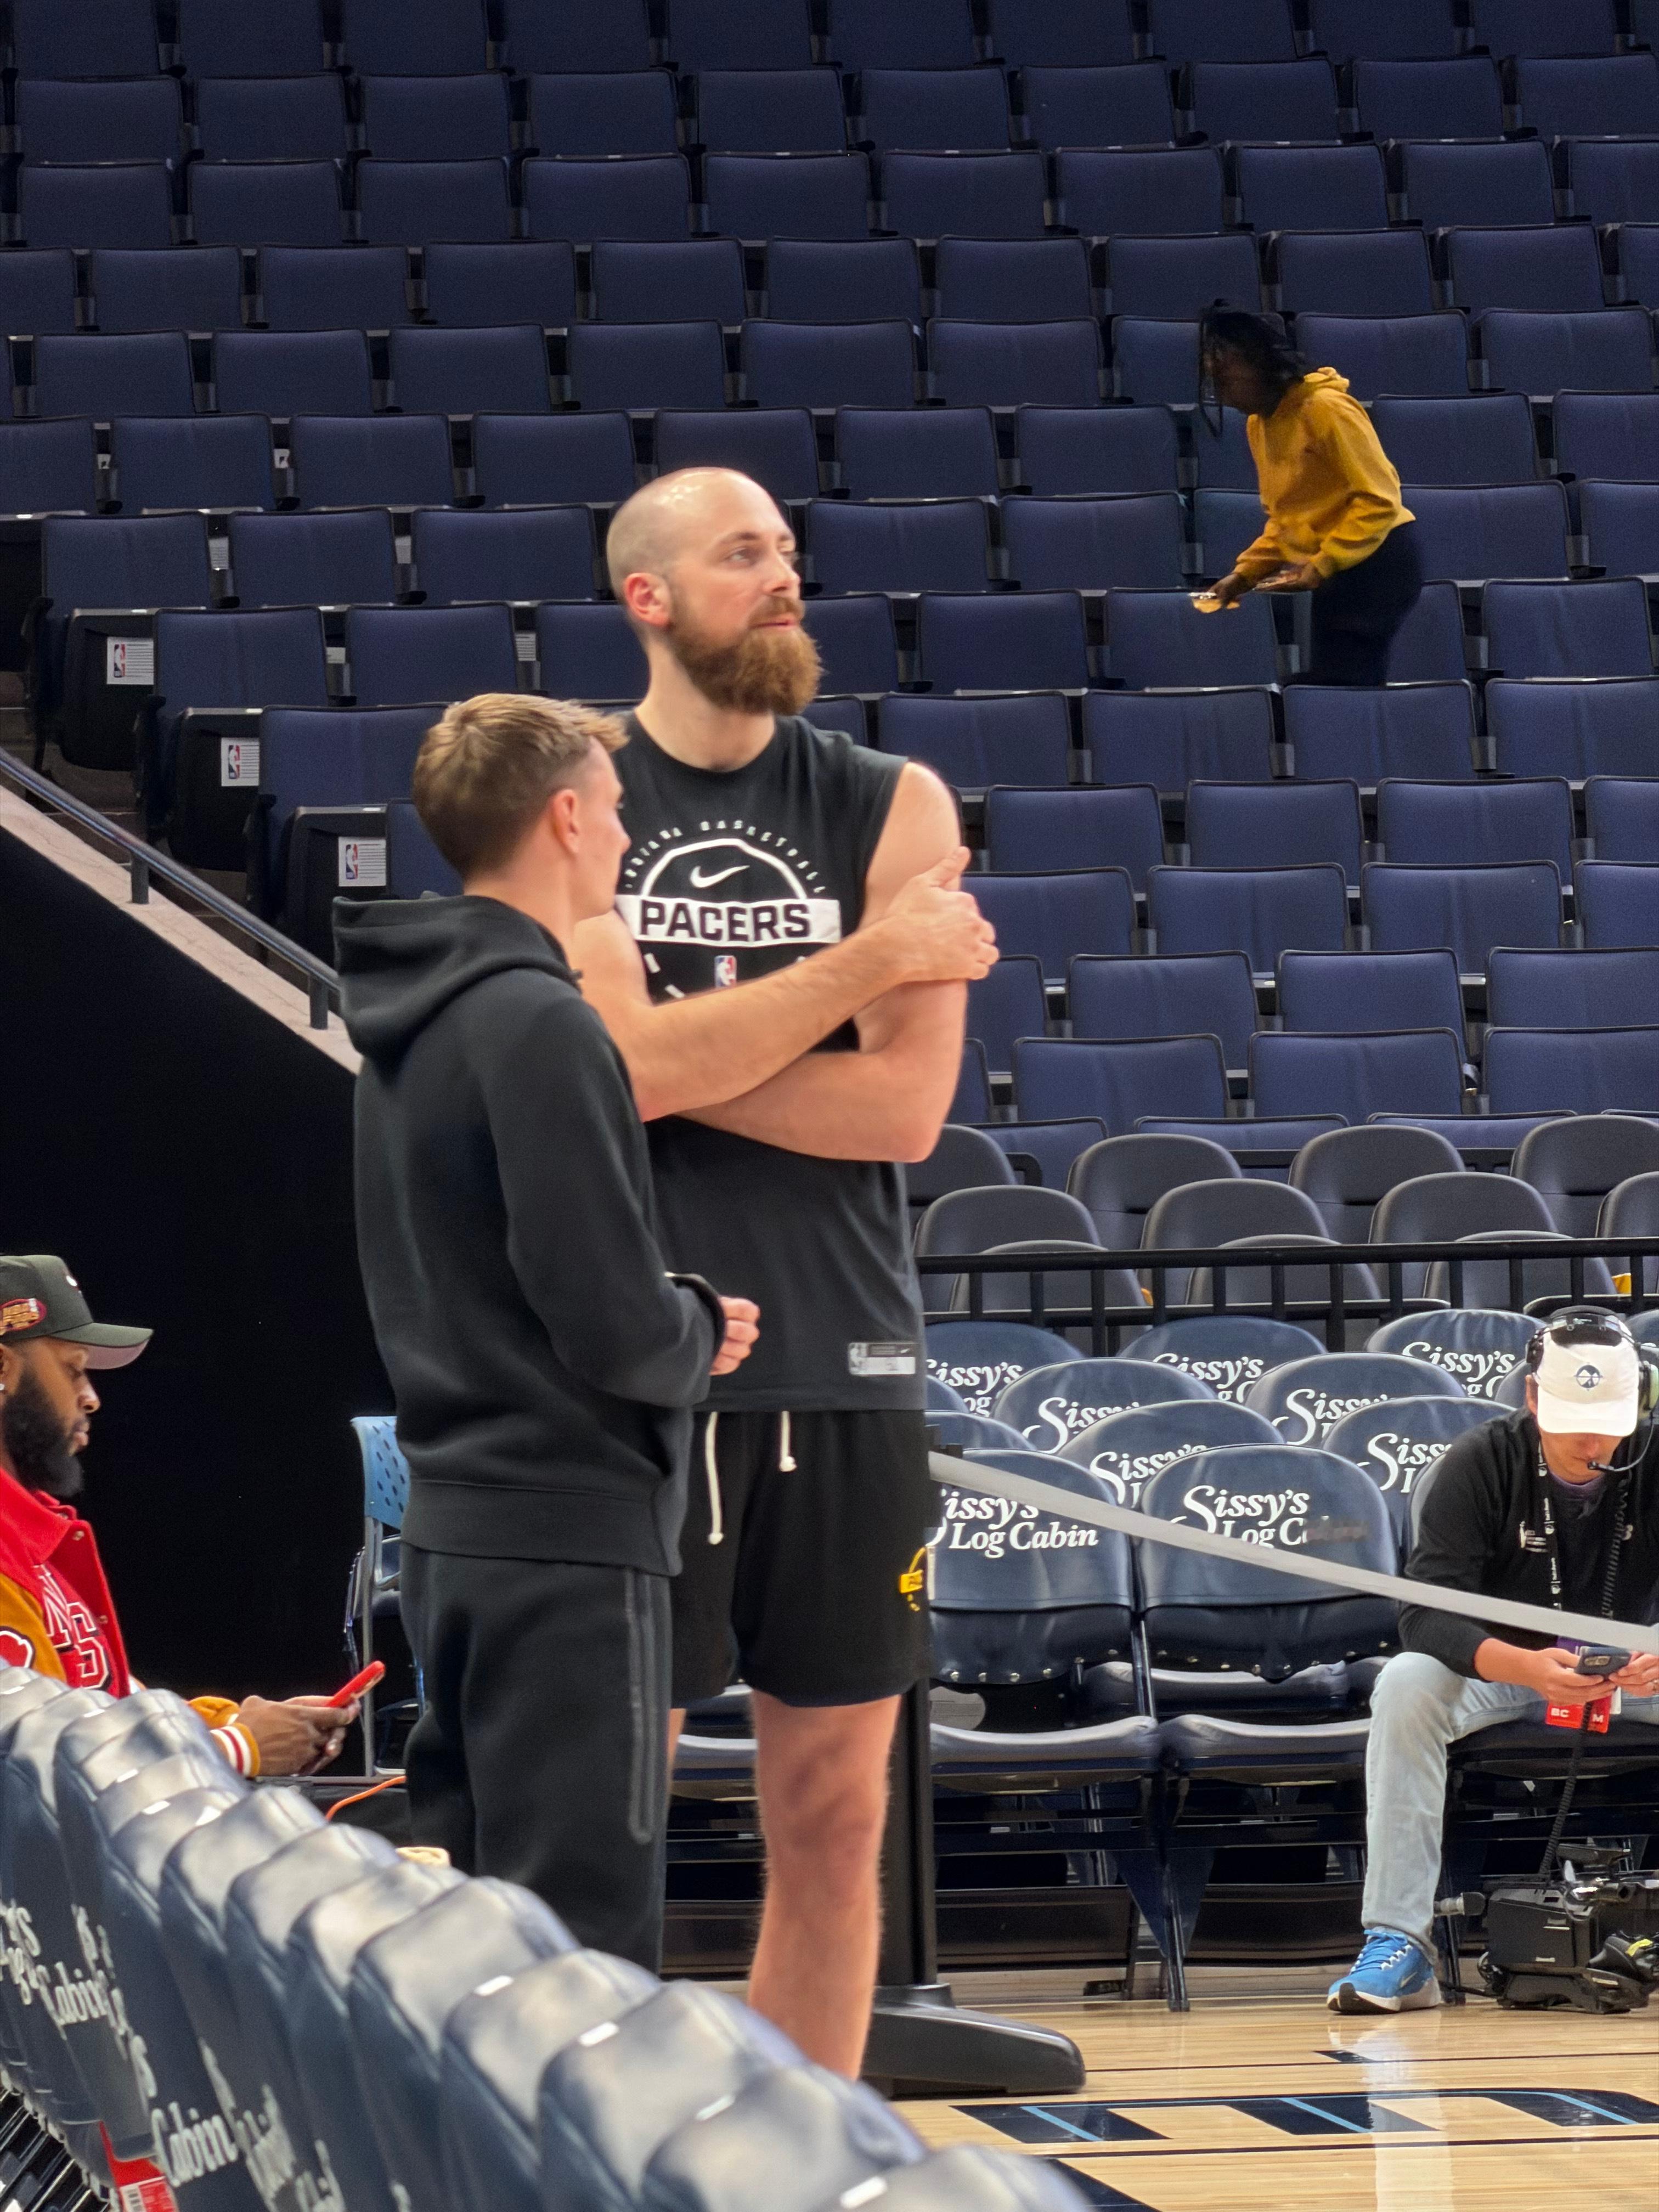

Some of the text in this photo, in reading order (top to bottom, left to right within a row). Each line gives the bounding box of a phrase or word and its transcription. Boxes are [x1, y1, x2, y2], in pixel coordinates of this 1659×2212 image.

[639, 899, 810, 941] PACERS
[925, 1358, 1023, 1395] issy's
[1170, 1485, 1310, 1534] Sissy's
[949, 1521, 1099, 1558] Log Cabin
